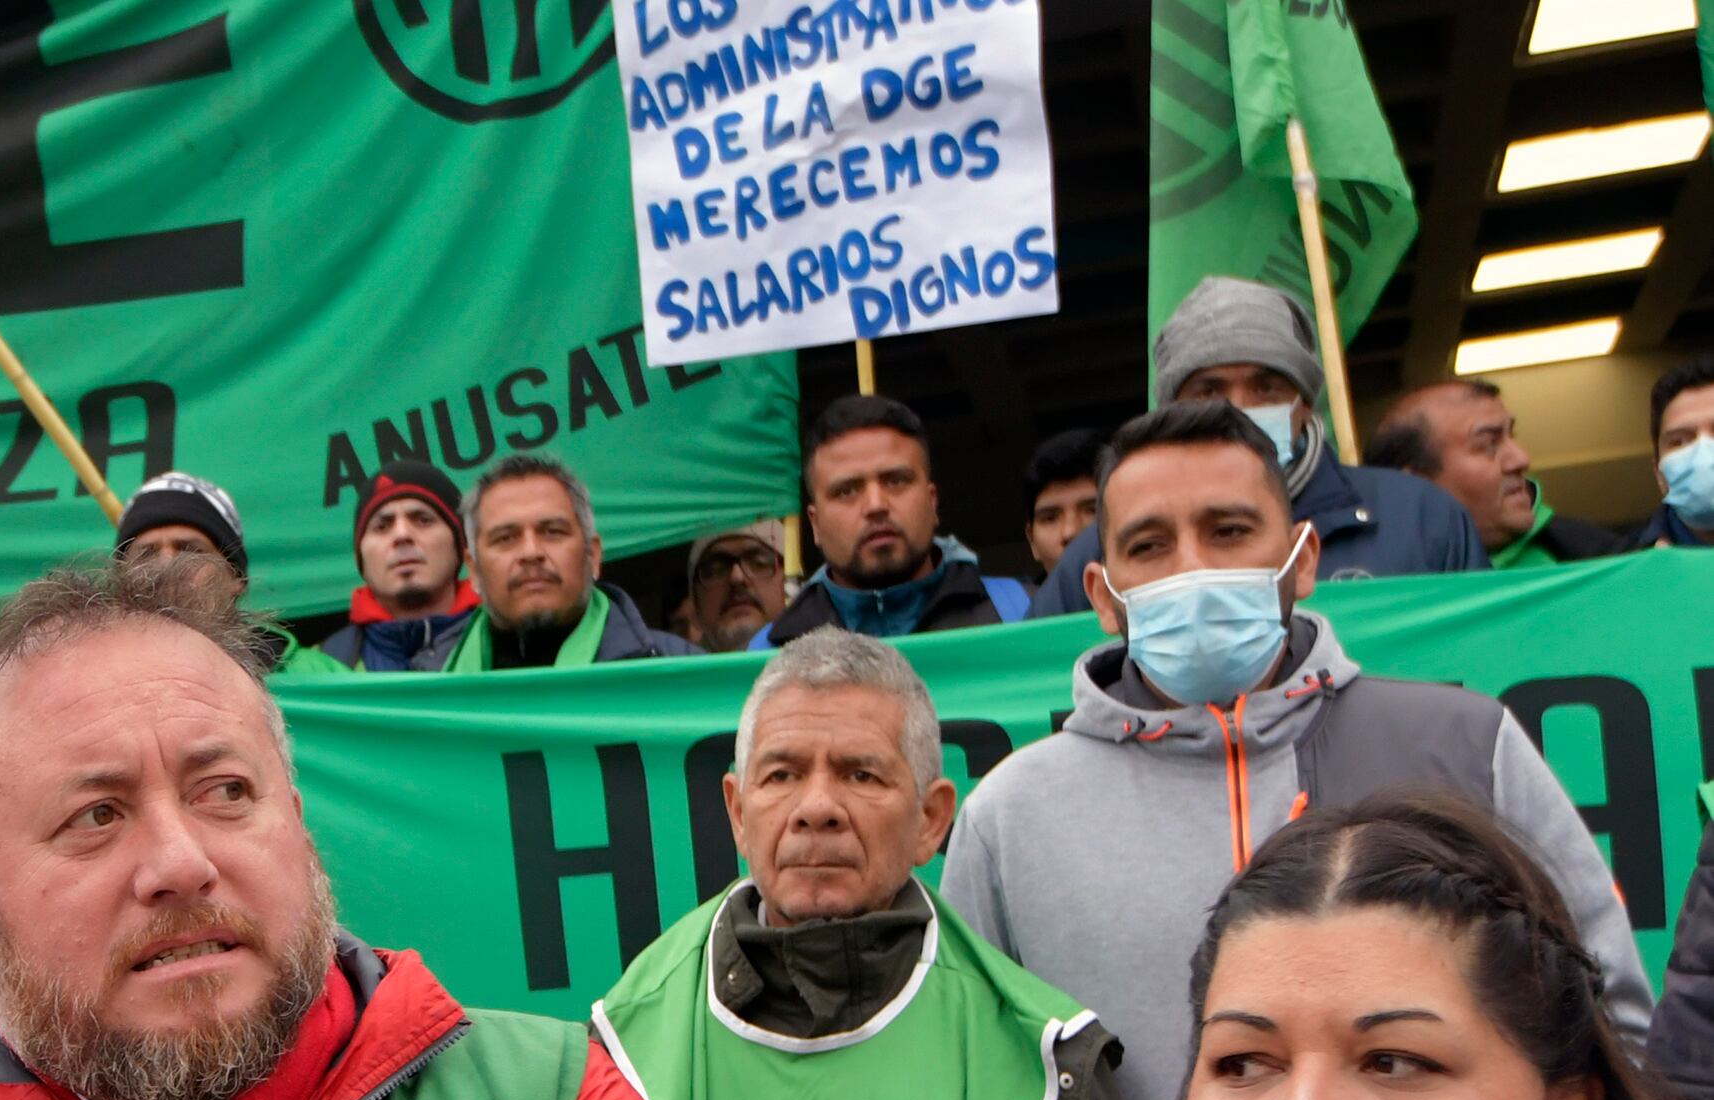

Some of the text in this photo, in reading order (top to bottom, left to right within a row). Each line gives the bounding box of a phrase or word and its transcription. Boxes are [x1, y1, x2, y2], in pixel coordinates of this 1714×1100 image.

[672, 43, 984, 180] DE LA DGE
[646, 119, 1001, 251] MERECEMOS
[655, 214, 905, 342] SALARIOS
[847, 226, 1057, 341] DIGNOS
